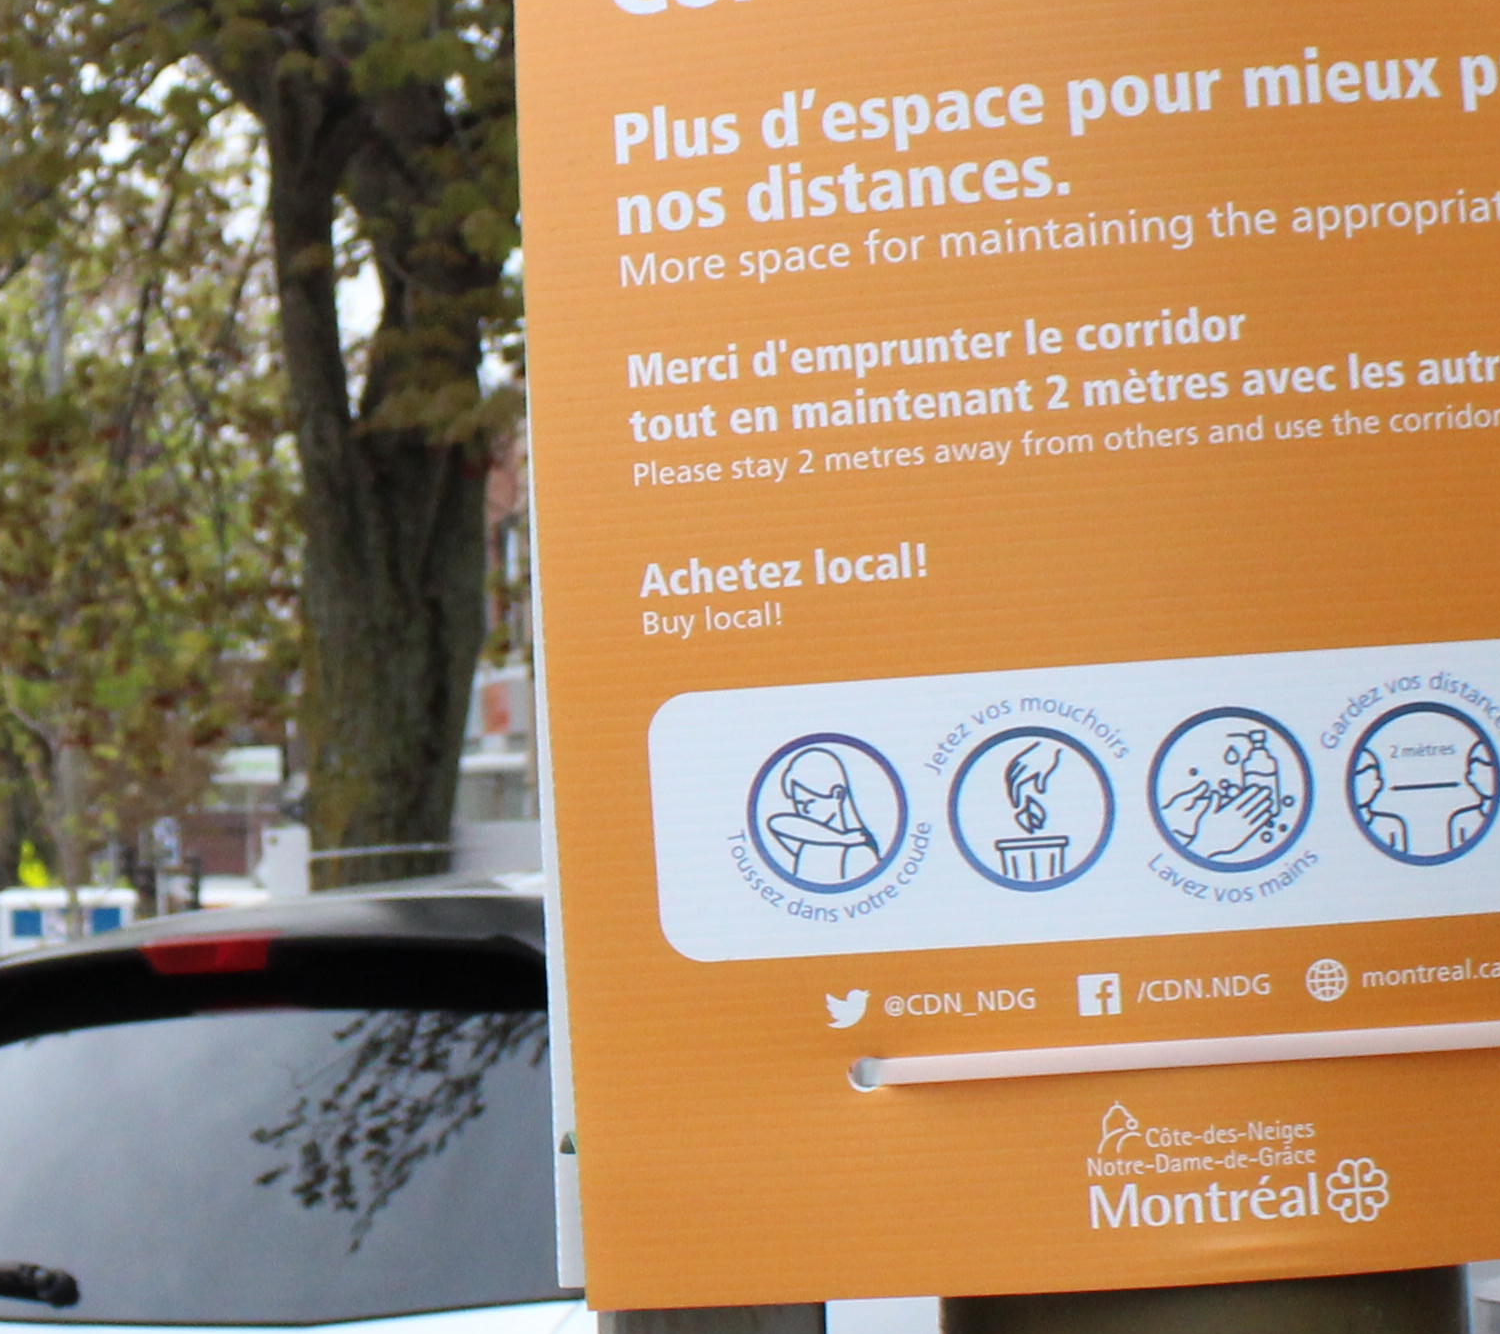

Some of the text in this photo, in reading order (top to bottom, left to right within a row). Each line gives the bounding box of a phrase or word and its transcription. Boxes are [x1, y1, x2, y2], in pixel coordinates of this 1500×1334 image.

[613, 104, 742, 165] Plus
[760, 87, 1044, 152] d’espace
[1065, 69, 1222, 137] pour
[1242, 47, 1441, 109] mieux
[616, 156, 1071, 236] nos distances.
[616, 251, 728, 289] More
[735, 242, 852, 284] space
[862, 228, 926, 265] for
[938, 209, 1194, 259] maintaining
[1206, 201, 1277, 238] the
[625, 306, 1246, 389] Merci d'emprunter le corridor
[627, 404, 718, 444] tout
[726, 405, 780, 437] en
[789, 379, 1034, 430] maintenant
[1044, 374, 1070, 411] 2
[1081, 368, 1229, 407] mètres
[1241, 365, 1336, 397] avec
[1348, 353, 1405, 390] les
[632, 460, 723, 487] Please
[729, 456, 789, 483] stay
[797, 449, 815, 474] 2
[824, 446, 926, 472] metres
[933, 440, 1012, 466] away
[1020, 430, 1094, 457] from
[1103, 423, 1199, 451] others
[1208, 415, 1264, 444] and
[1274, 419, 1322, 440] use
[1331, 410, 1380, 436] the
[639, 541, 928, 598] Achetez local!
[641, 601, 782, 640] Buy local!
[924, 696, 1130, 775] Jetez vos mouchoirs
[1320, 686, 1382, 750] Gardez
[1385, 673, 1421, 696] vos
[1389, 741, 1456, 759] 2 mètres
[727, 821, 932, 923] Toussez dans votre coude
[1147, 848, 1320, 903] Lavez vos mains
[884, 988, 1036, 1017] @CDN_NDG
[1137, 973, 1270, 1002] /CDN.NDG
[1086, 1145, 1316, 1177] Notre-Dame-de-Grâce
[1145, 1121, 1315, 1148] Côte-des-Neiges
[1088, 1171, 1320, 1229] Montréal
